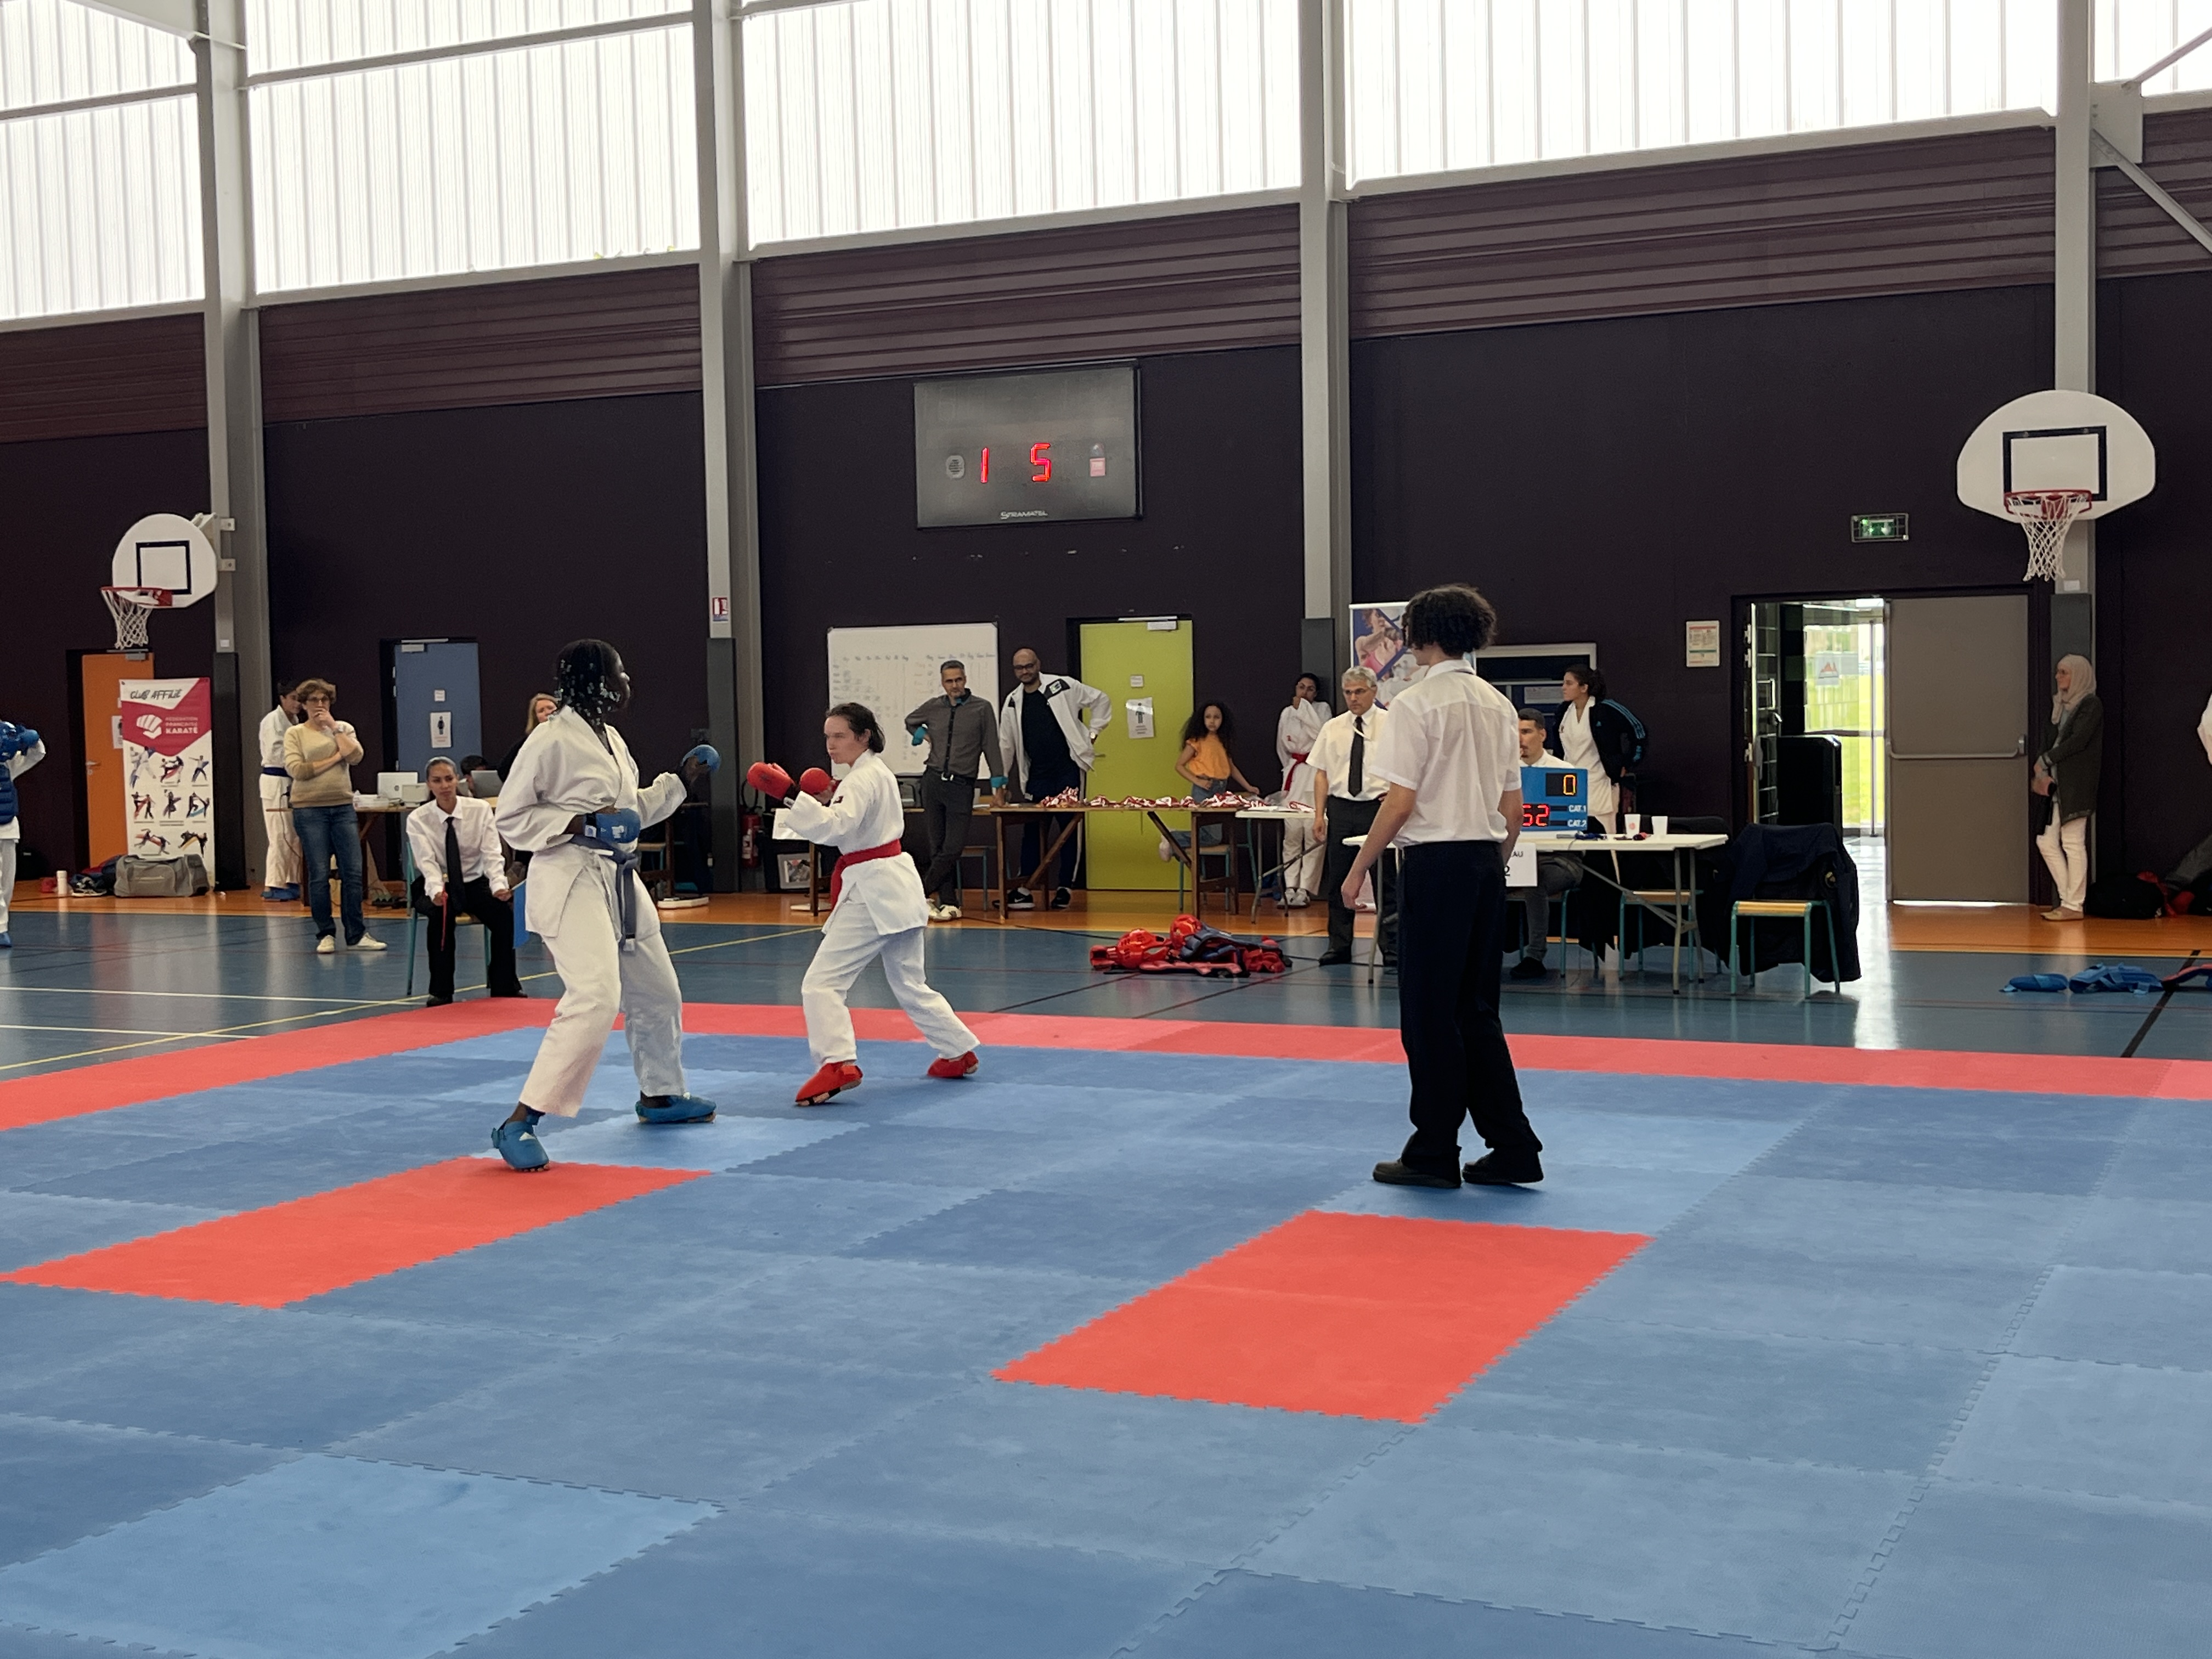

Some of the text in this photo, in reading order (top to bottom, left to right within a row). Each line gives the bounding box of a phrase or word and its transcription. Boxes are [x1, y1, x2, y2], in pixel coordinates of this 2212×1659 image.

[981, 447, 989, 483] 1
[1030, 443, 1052, 482] 5
[1563, 774, 1576, 795] 0
